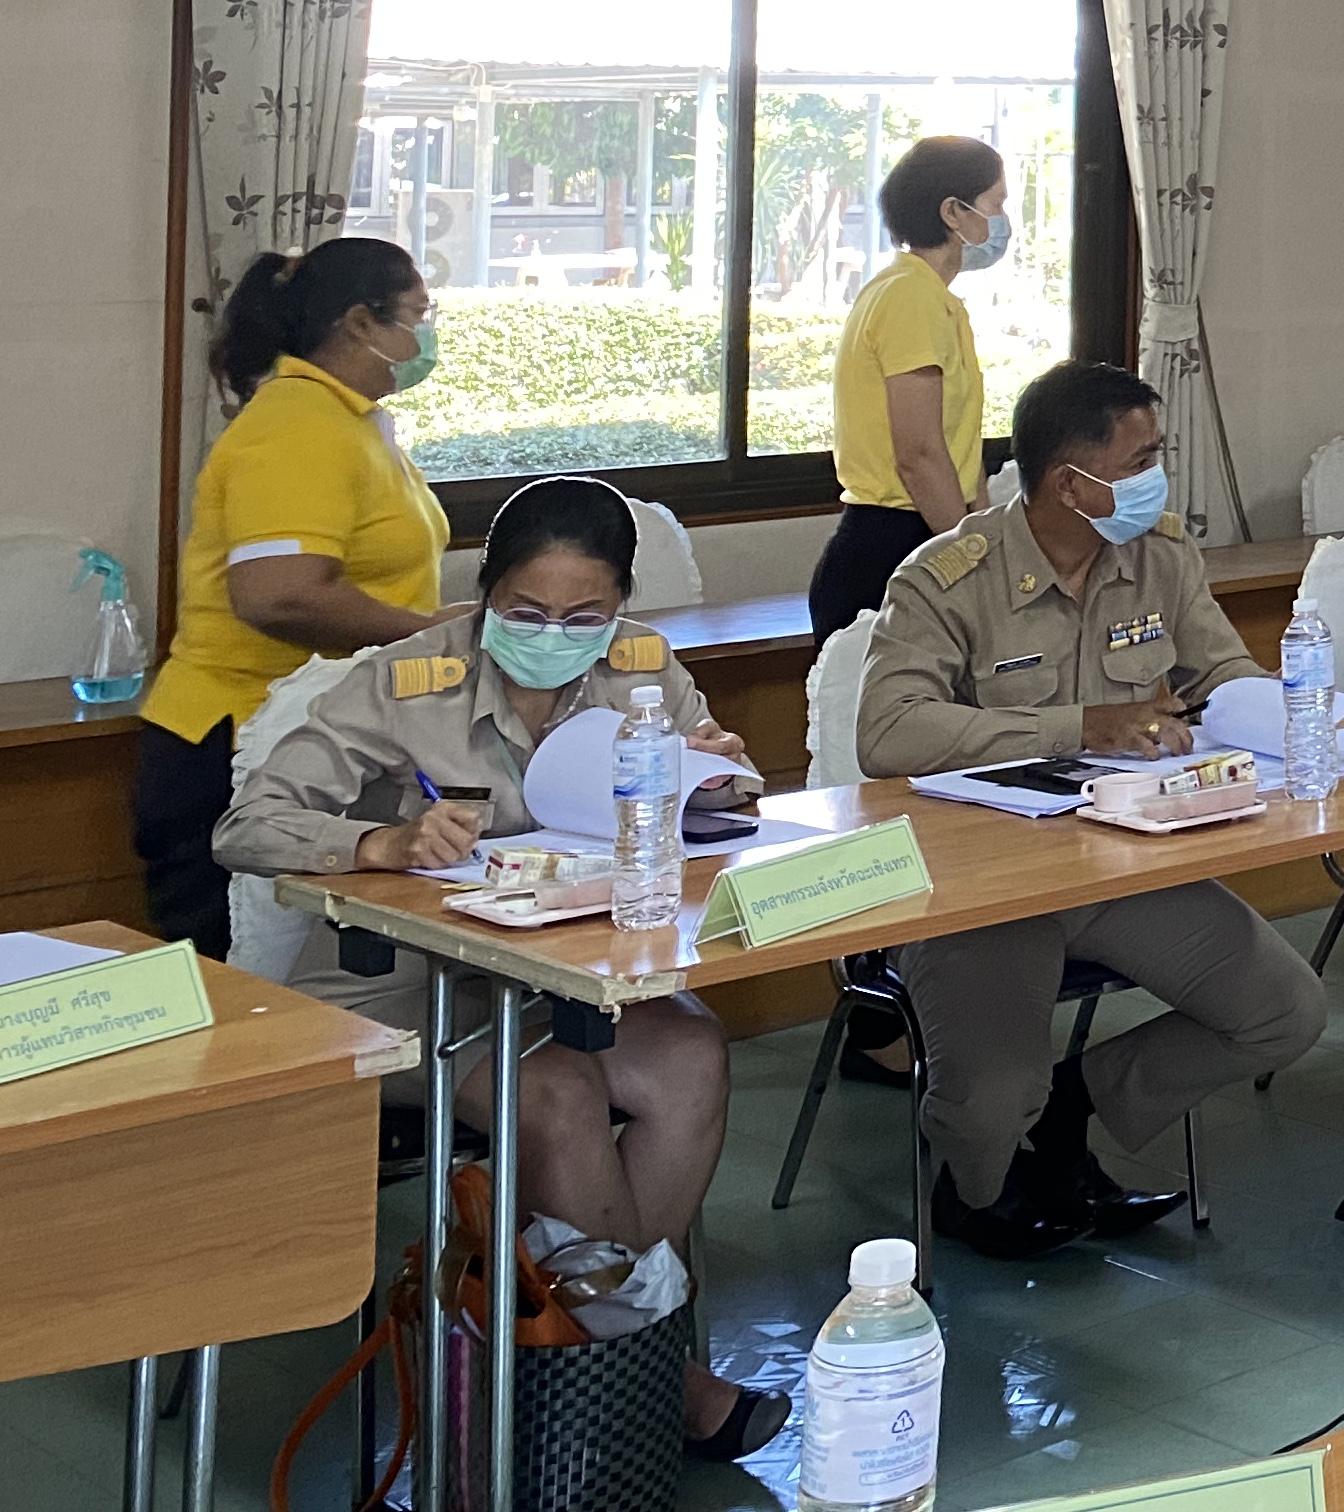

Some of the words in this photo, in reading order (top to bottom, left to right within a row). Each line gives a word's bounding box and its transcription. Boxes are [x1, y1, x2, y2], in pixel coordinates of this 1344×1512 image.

[750, 853, 914, 920] อุตสาหกรรมจังหวัดฉะเชิงเทรา
